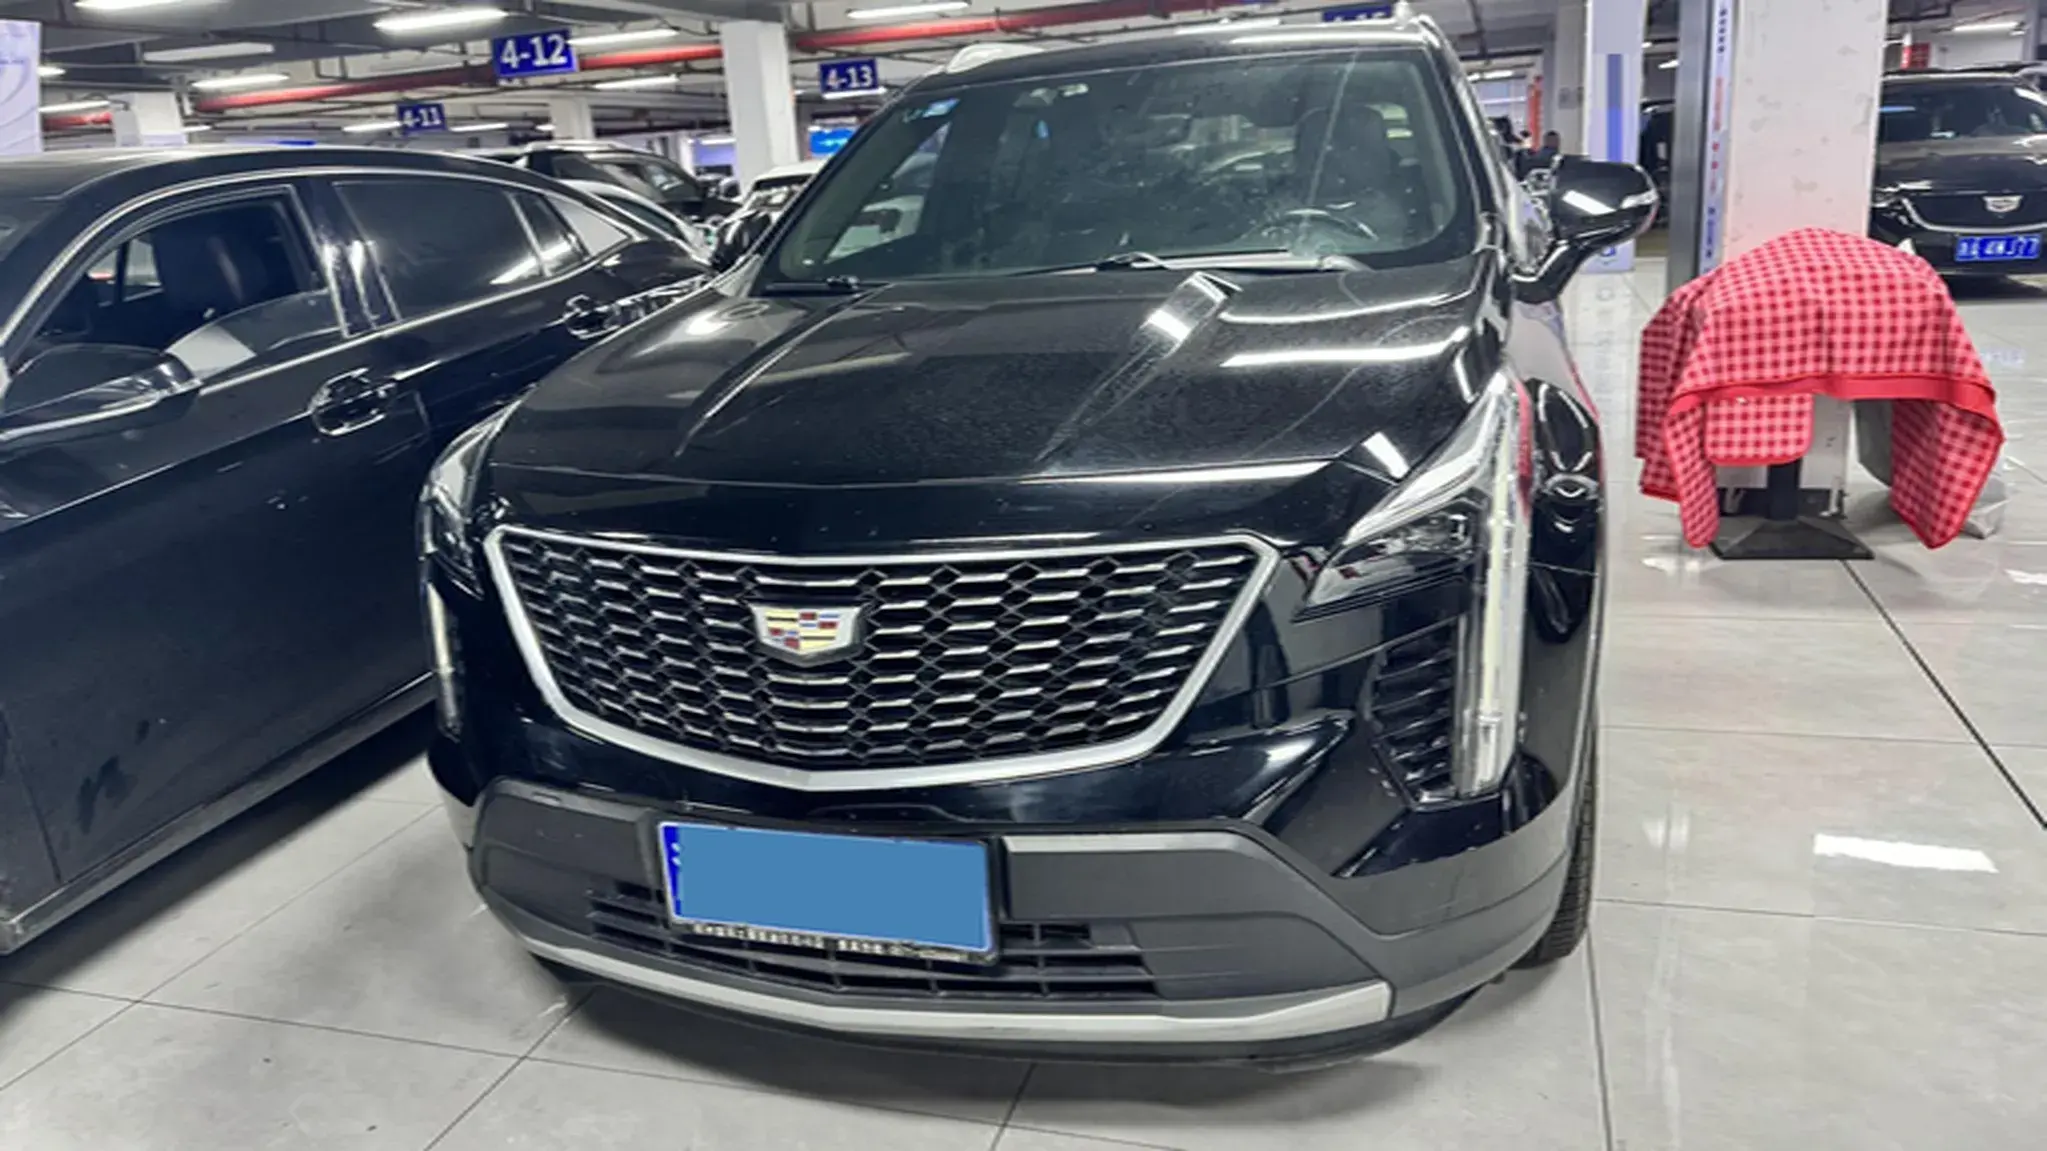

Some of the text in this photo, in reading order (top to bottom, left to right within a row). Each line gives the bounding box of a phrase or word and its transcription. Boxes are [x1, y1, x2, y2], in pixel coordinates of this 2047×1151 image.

[501, 34, 567, 69] 4-12
[827, 65, 872, 89] 4-13
[403, 107, 441, 127] 4-11
